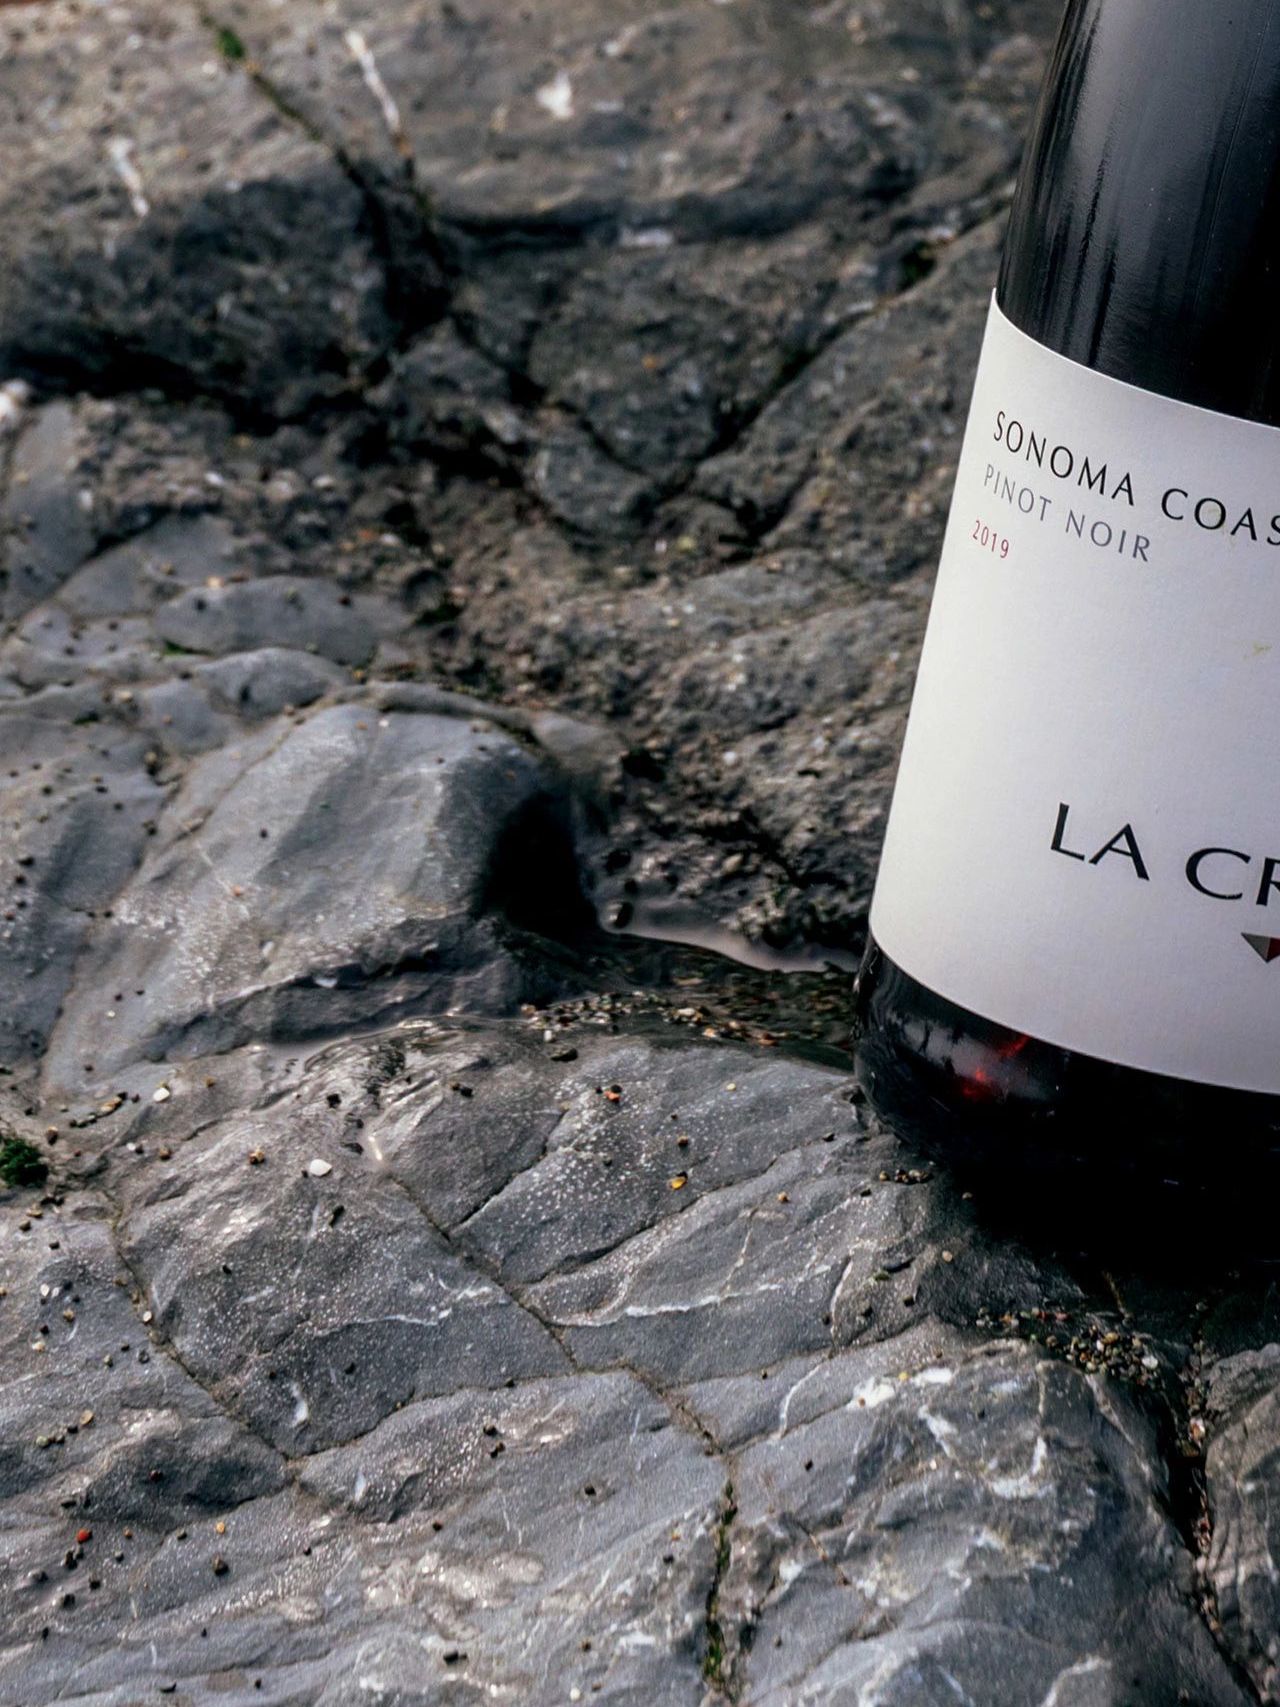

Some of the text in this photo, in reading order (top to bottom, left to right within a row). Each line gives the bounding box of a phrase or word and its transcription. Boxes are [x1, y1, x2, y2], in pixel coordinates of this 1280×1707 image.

[993, 410, 1135, 507] SONOMA
[971, 519, 1010, 559] 2019
[983, 463, 1151, 563] PINOT NOIR
[1050, 802, 1150, 882] LA
